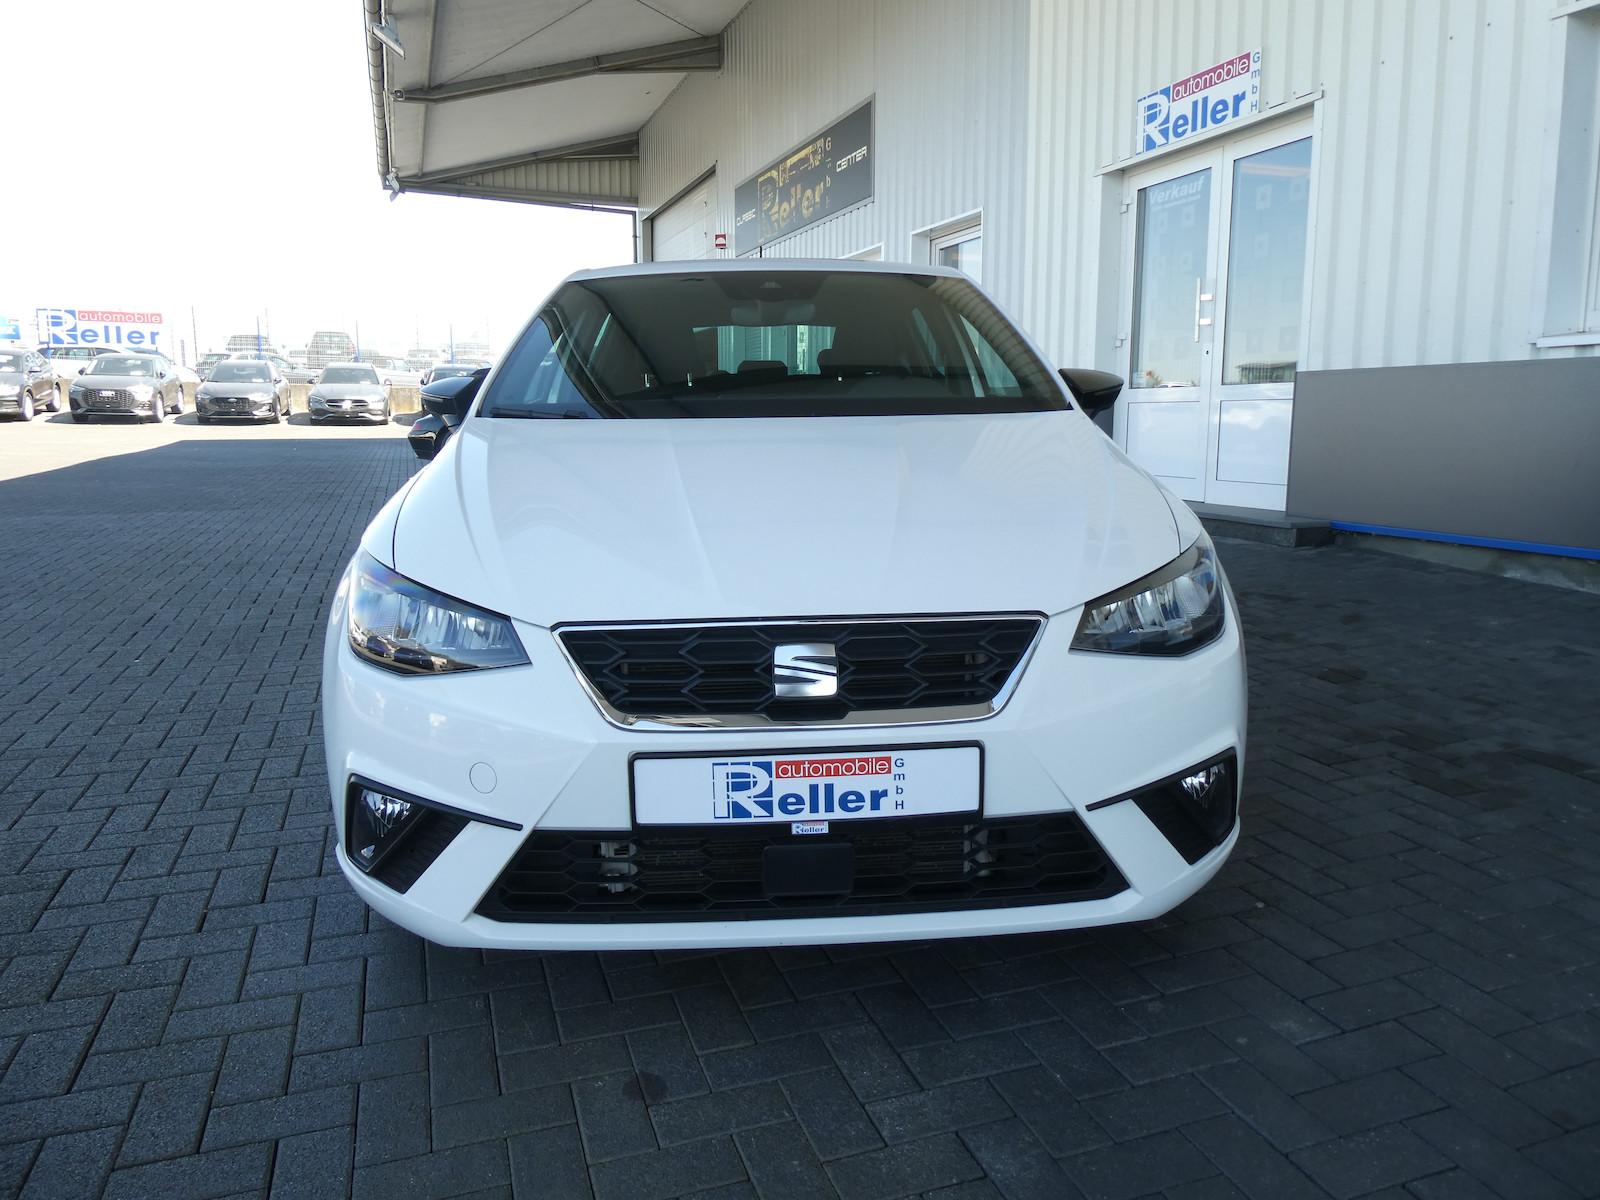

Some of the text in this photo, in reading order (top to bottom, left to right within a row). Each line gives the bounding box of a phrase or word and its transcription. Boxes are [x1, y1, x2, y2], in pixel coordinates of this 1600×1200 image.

[1173, 57, 1249, 100] automobile
[1250, 51, 1261, 113] GmbH
[1135, 85, 1247, 155] Reller
[836, 145, 868, 172] CENTER
[1148, 176, 1205, 204] Verkauf
[36, 308, 160, 345] Reller
[79, 311, 162, 323] automobile
[778, 757, 890, 778] automobile
[894, 758, 905, 811] GmbH
[712, 760, 889, 819] Reller
